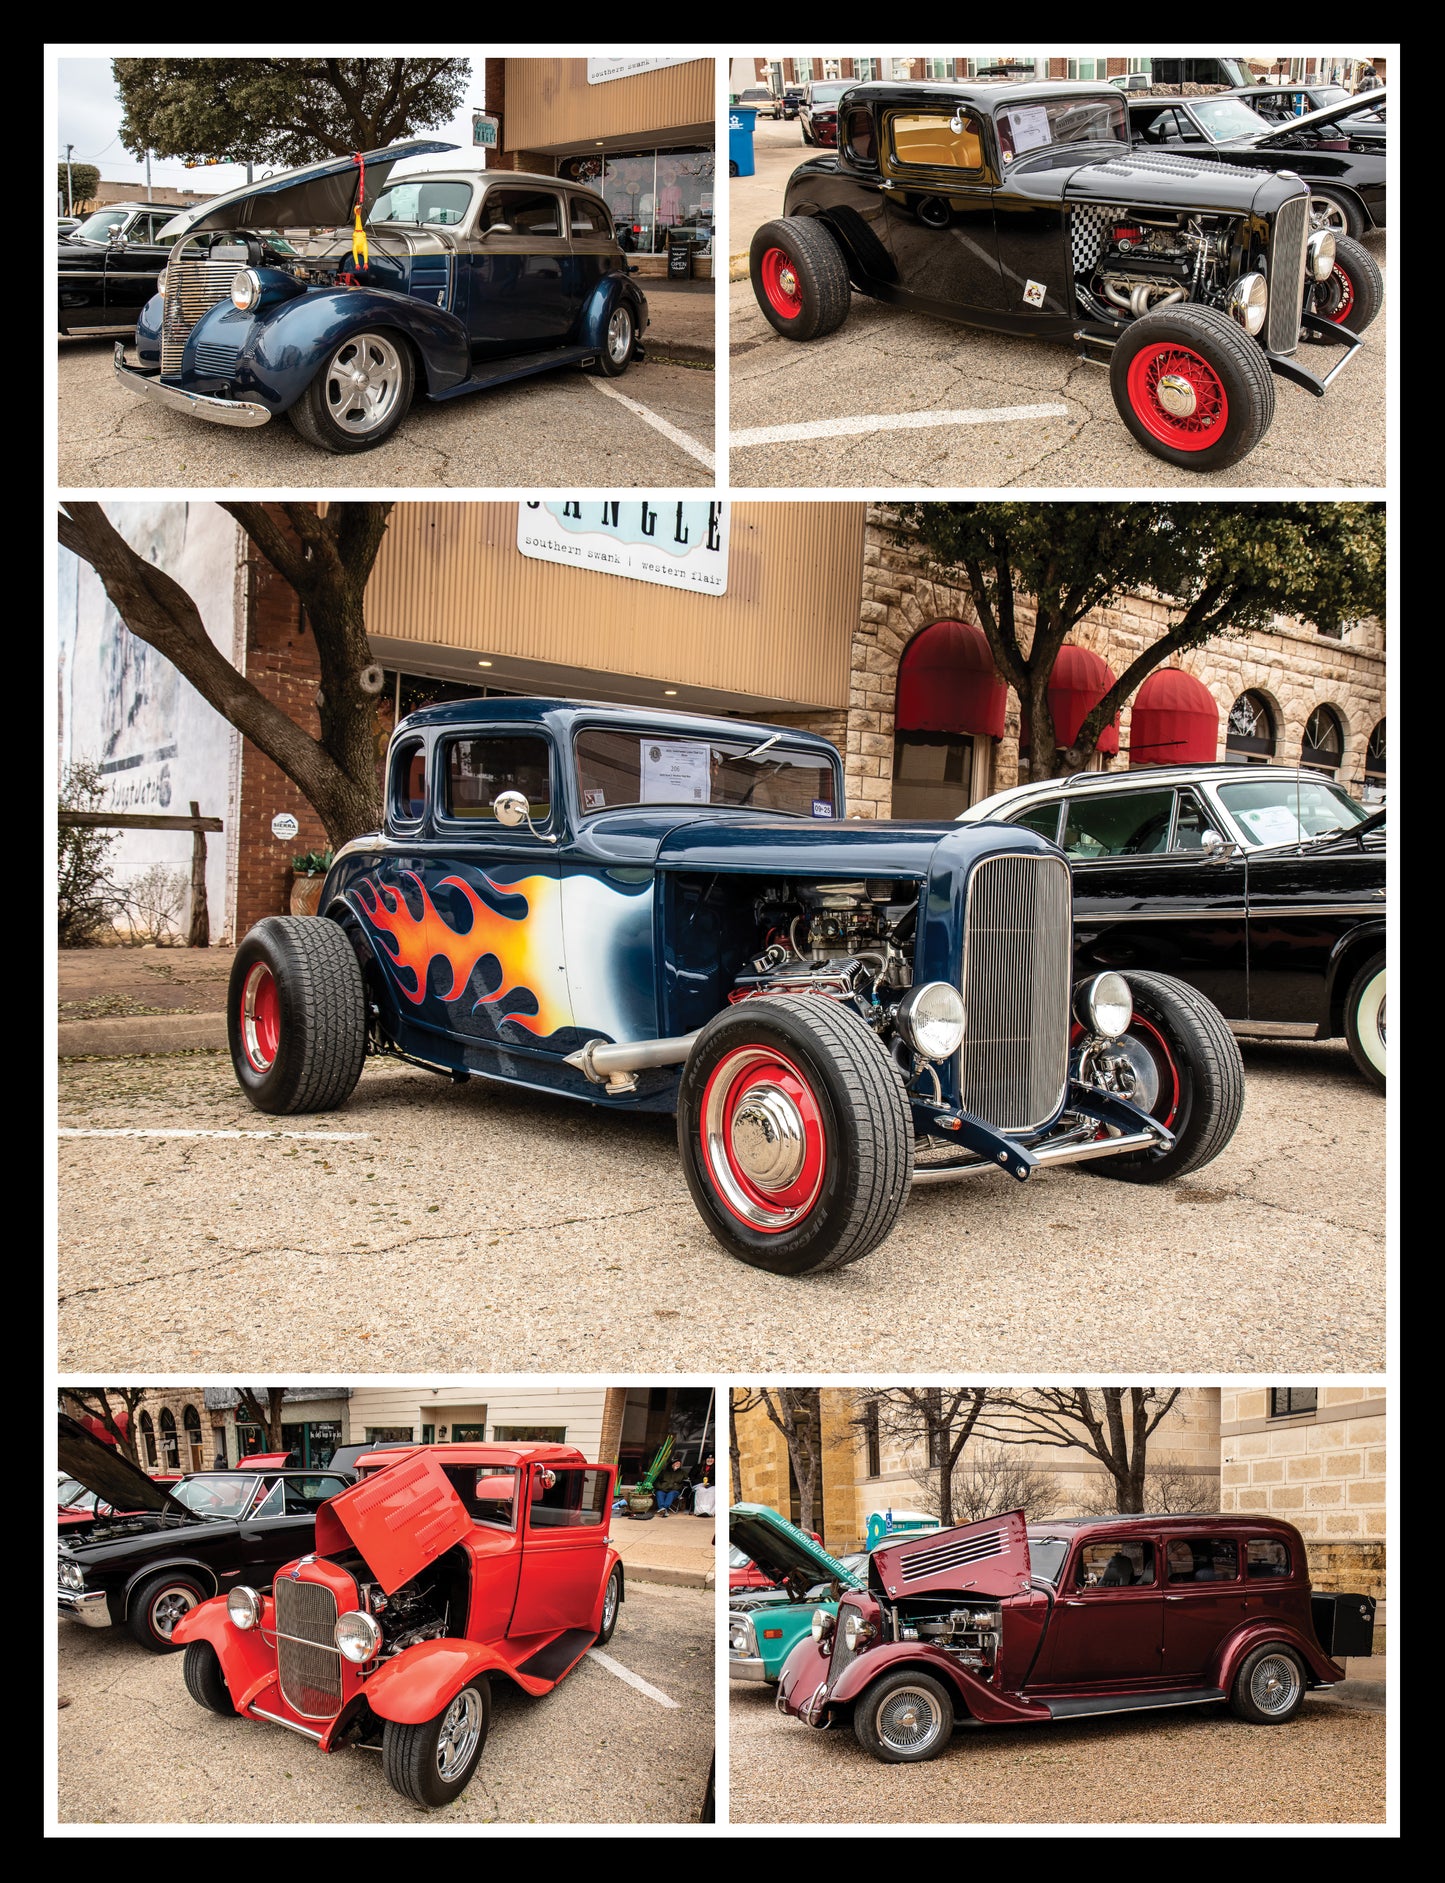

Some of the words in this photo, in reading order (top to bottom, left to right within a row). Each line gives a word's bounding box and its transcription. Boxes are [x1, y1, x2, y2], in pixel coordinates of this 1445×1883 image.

[591, 66, 625, 79] southern
[627, 58, 650, 70] swank
[527, 501, 722, 551] NGLE
[525, 535, 582, 556] southern
[587, 548, 621, 564] swank
[641, 561, 686, 578] western
[691, 570, 722, 586] flair
[814, 804, 830, 814] 09-25
